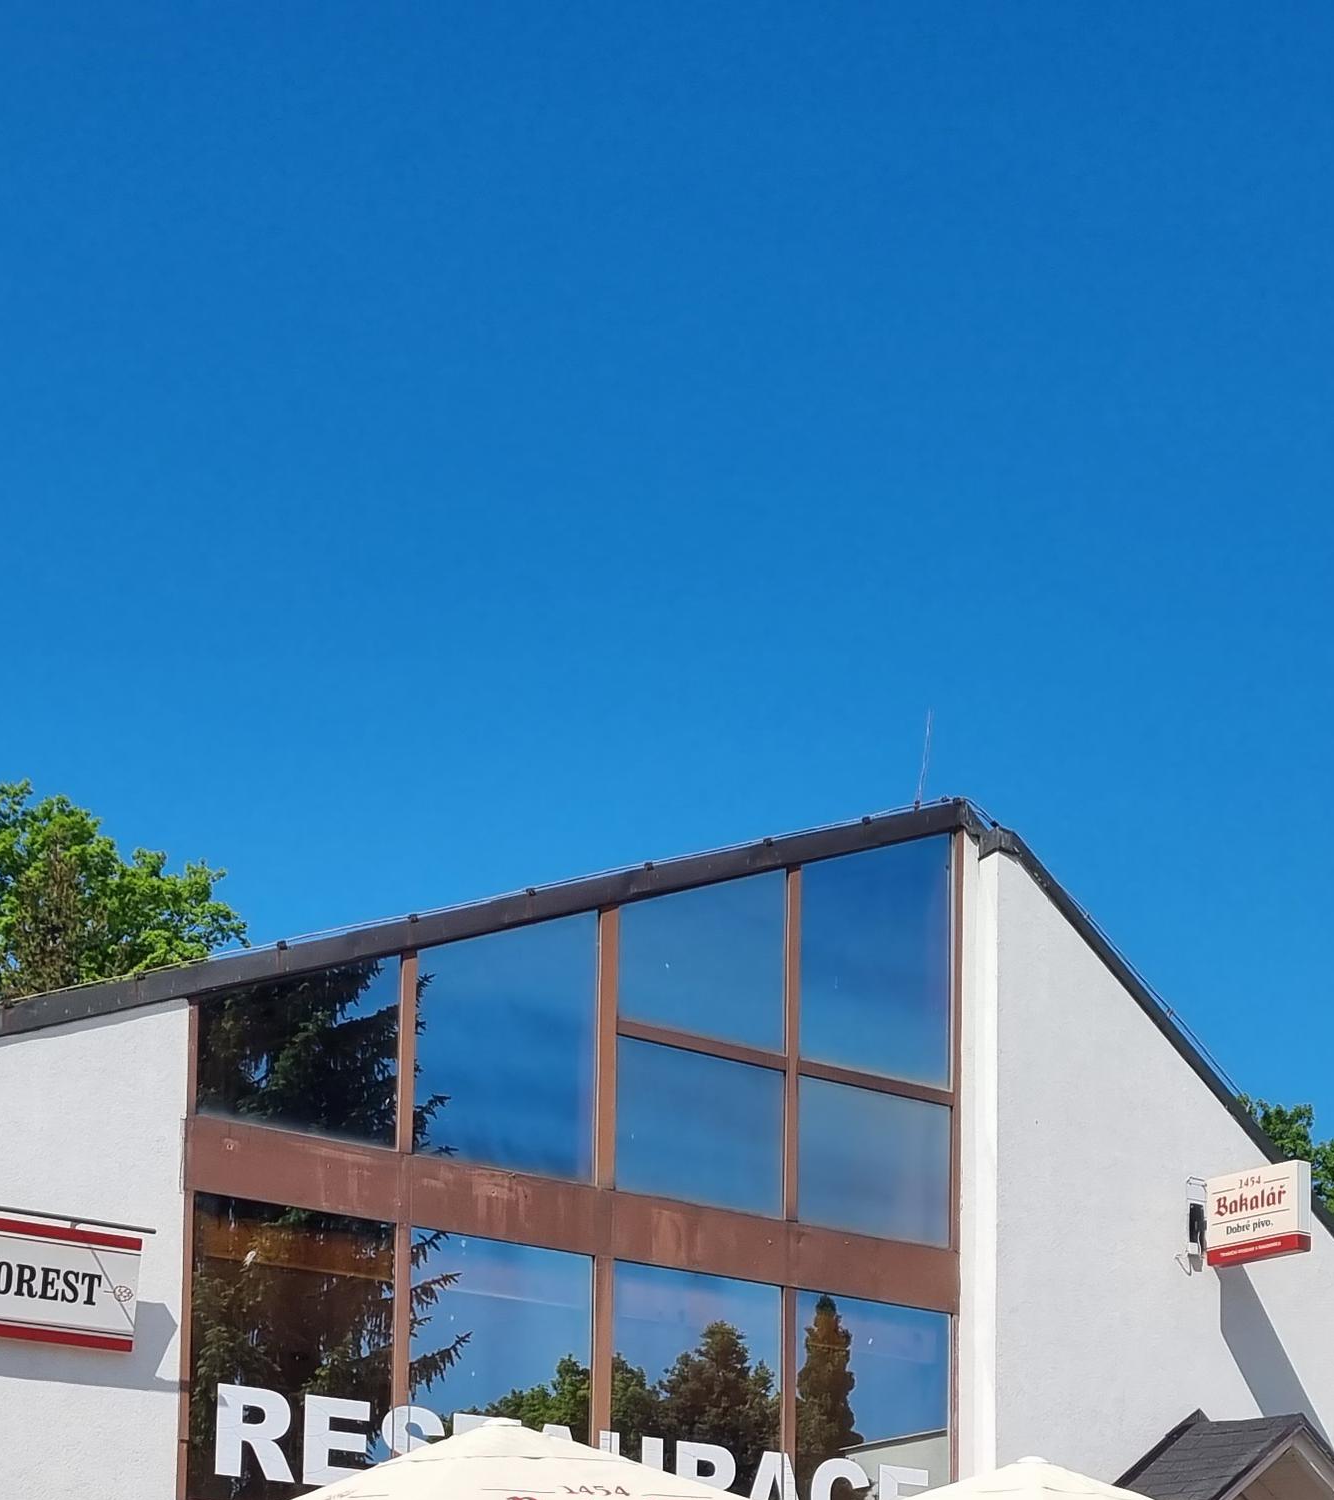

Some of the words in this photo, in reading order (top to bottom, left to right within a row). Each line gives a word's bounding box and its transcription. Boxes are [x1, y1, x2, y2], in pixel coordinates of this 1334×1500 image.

[1239, 1176, 1261, 1189] 1454
[1214, 1184, 1287, 1217] Bakalář
[1226, 1220, 1251, 1235] Dobré
[1252, 1218, 1274, 1232] pivo.
[559, 1486, 630, 1496] 1454
